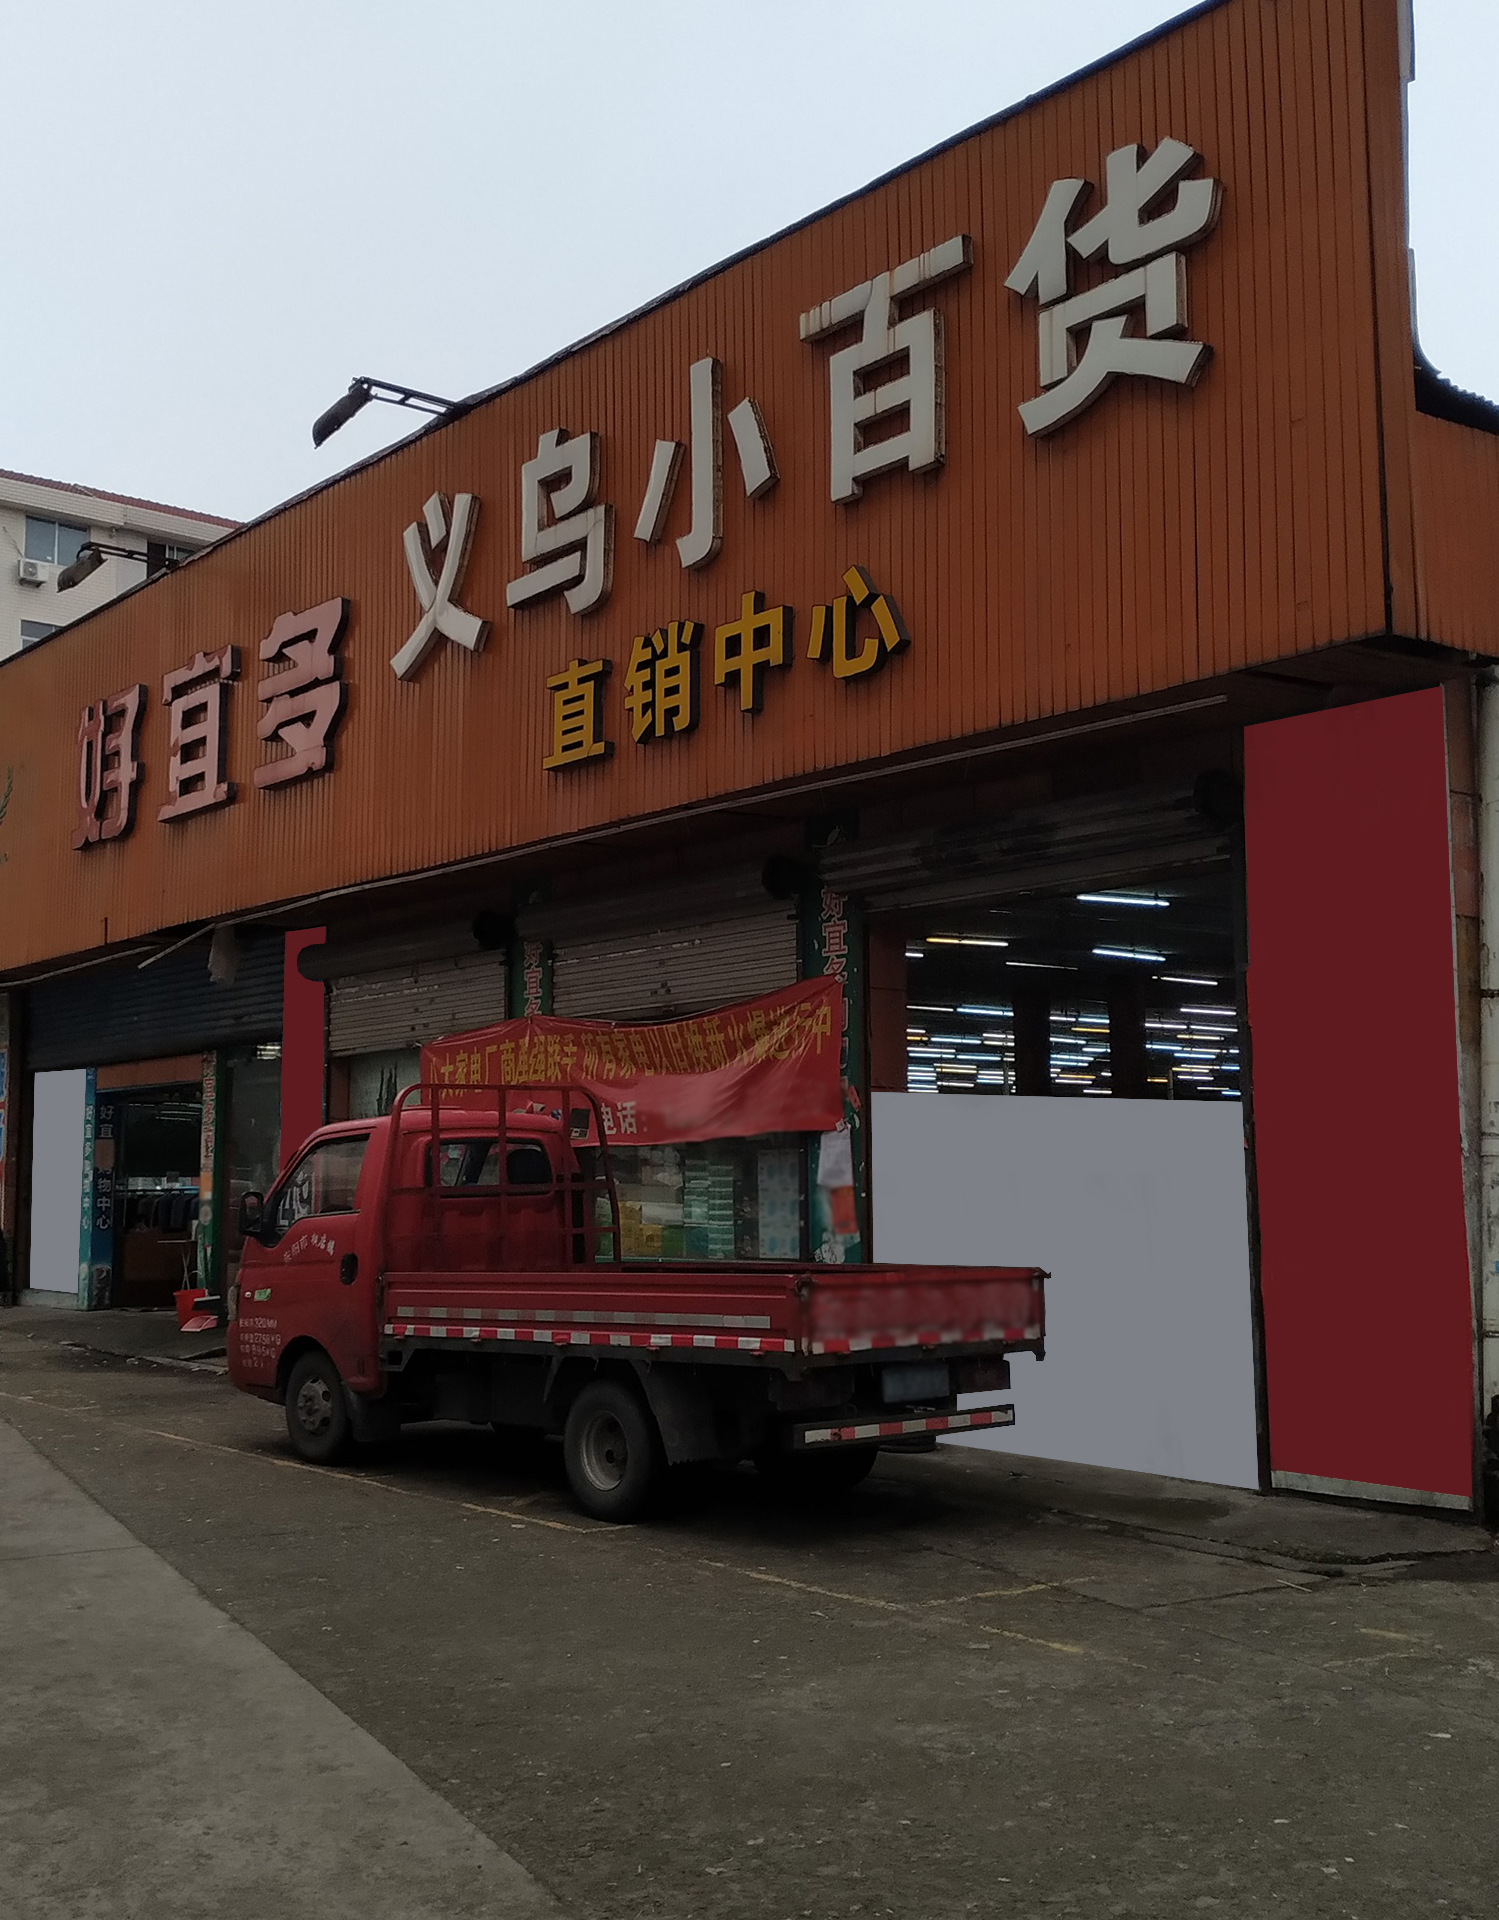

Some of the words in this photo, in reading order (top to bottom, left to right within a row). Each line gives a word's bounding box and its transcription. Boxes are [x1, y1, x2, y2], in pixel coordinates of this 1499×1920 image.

[389, 136, 1223, 681] 义乌小百货
[72, 596, 350, 850] 好宜多
[542, 565, 911, 771] 直销中心
[96, 1105, 115, 1231] 好宜物中心
